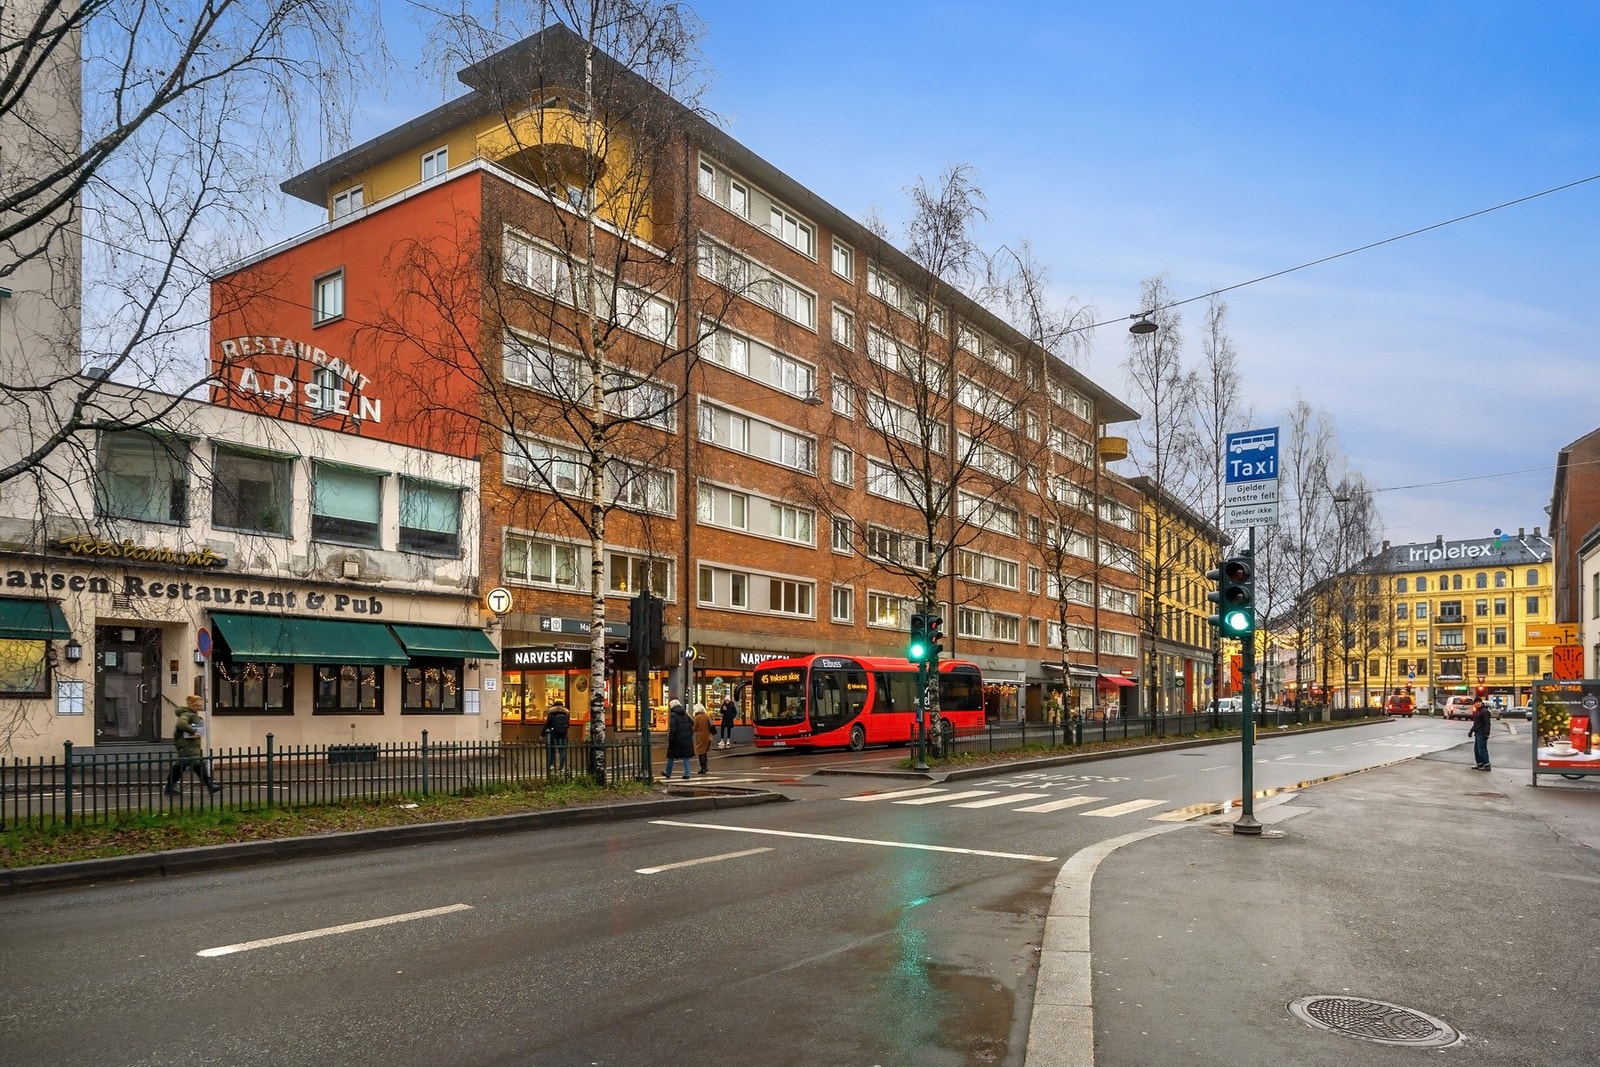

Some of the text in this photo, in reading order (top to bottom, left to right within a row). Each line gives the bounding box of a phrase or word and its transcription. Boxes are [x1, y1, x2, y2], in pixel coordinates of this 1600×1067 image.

[220, 336, 371, 391] RESTAURANT
[1230, 456, 1274, 476] Taxi
[1237, 484, 1266, 493] Gjelder
[1261, 492, 1275, 500] felt
[1231, 509, 1256, 517] Gjelder
[1230, 516, 1273, 524] elmotorvogn
[1409, 542, 1492, 564] tripletex
[0, 570, 383, 615] arsen Restaurant & Pub
[493, 595, 505, 610] T
[515, 650, 573, 664] NARVESEN
[822, 659, 842, 668] Elbuss
[761, 674, 769, 684] 45
[1011, 773, 1131, 783] BUSS
[972, 780, 1091, 791] TAXI
